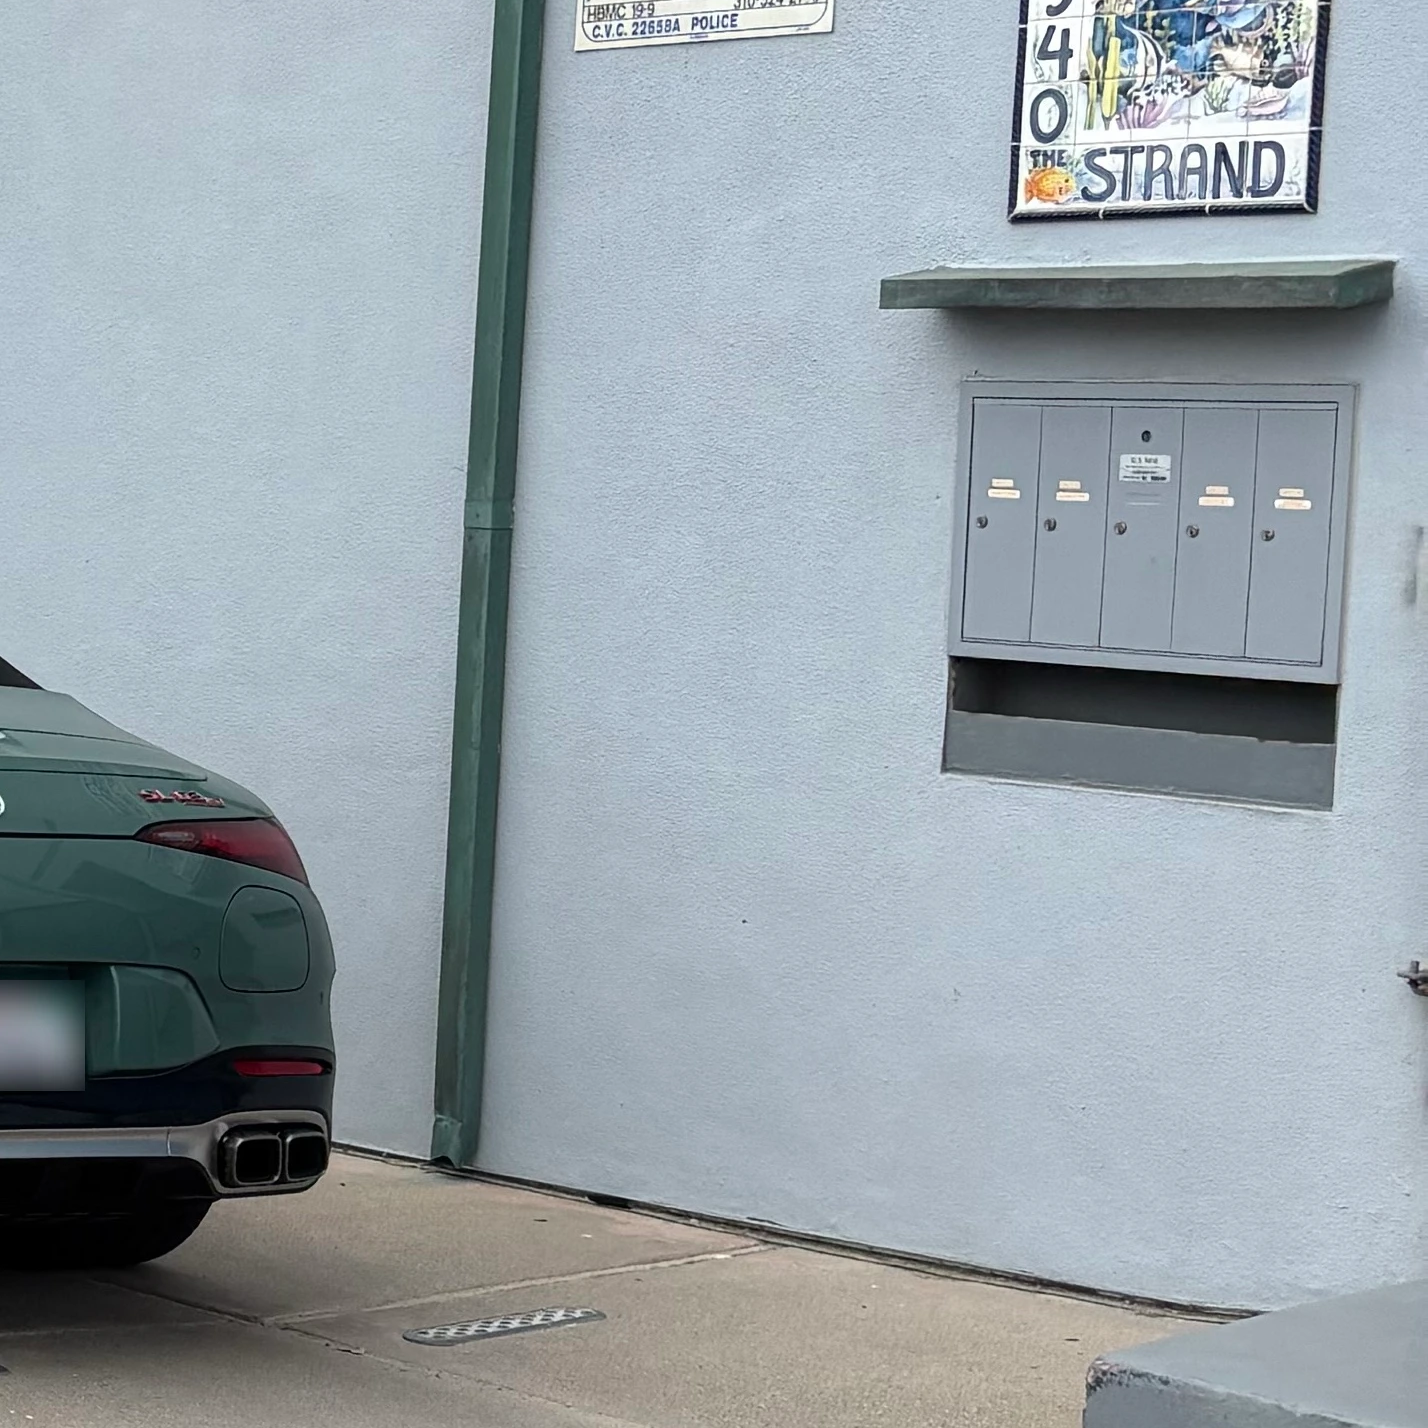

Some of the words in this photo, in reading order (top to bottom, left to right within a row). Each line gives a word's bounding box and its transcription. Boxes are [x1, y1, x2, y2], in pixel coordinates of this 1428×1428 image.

[586, 4, 627, 22] HBMC
[592, 22, 628, 39] C.V.C.
[631, 18, 681, 36] 22658A
[691, 13, 739, 32] POLICE
[1029, 148, 1068, 169] THE
[1080, 139, 1286, 202] STRAND
